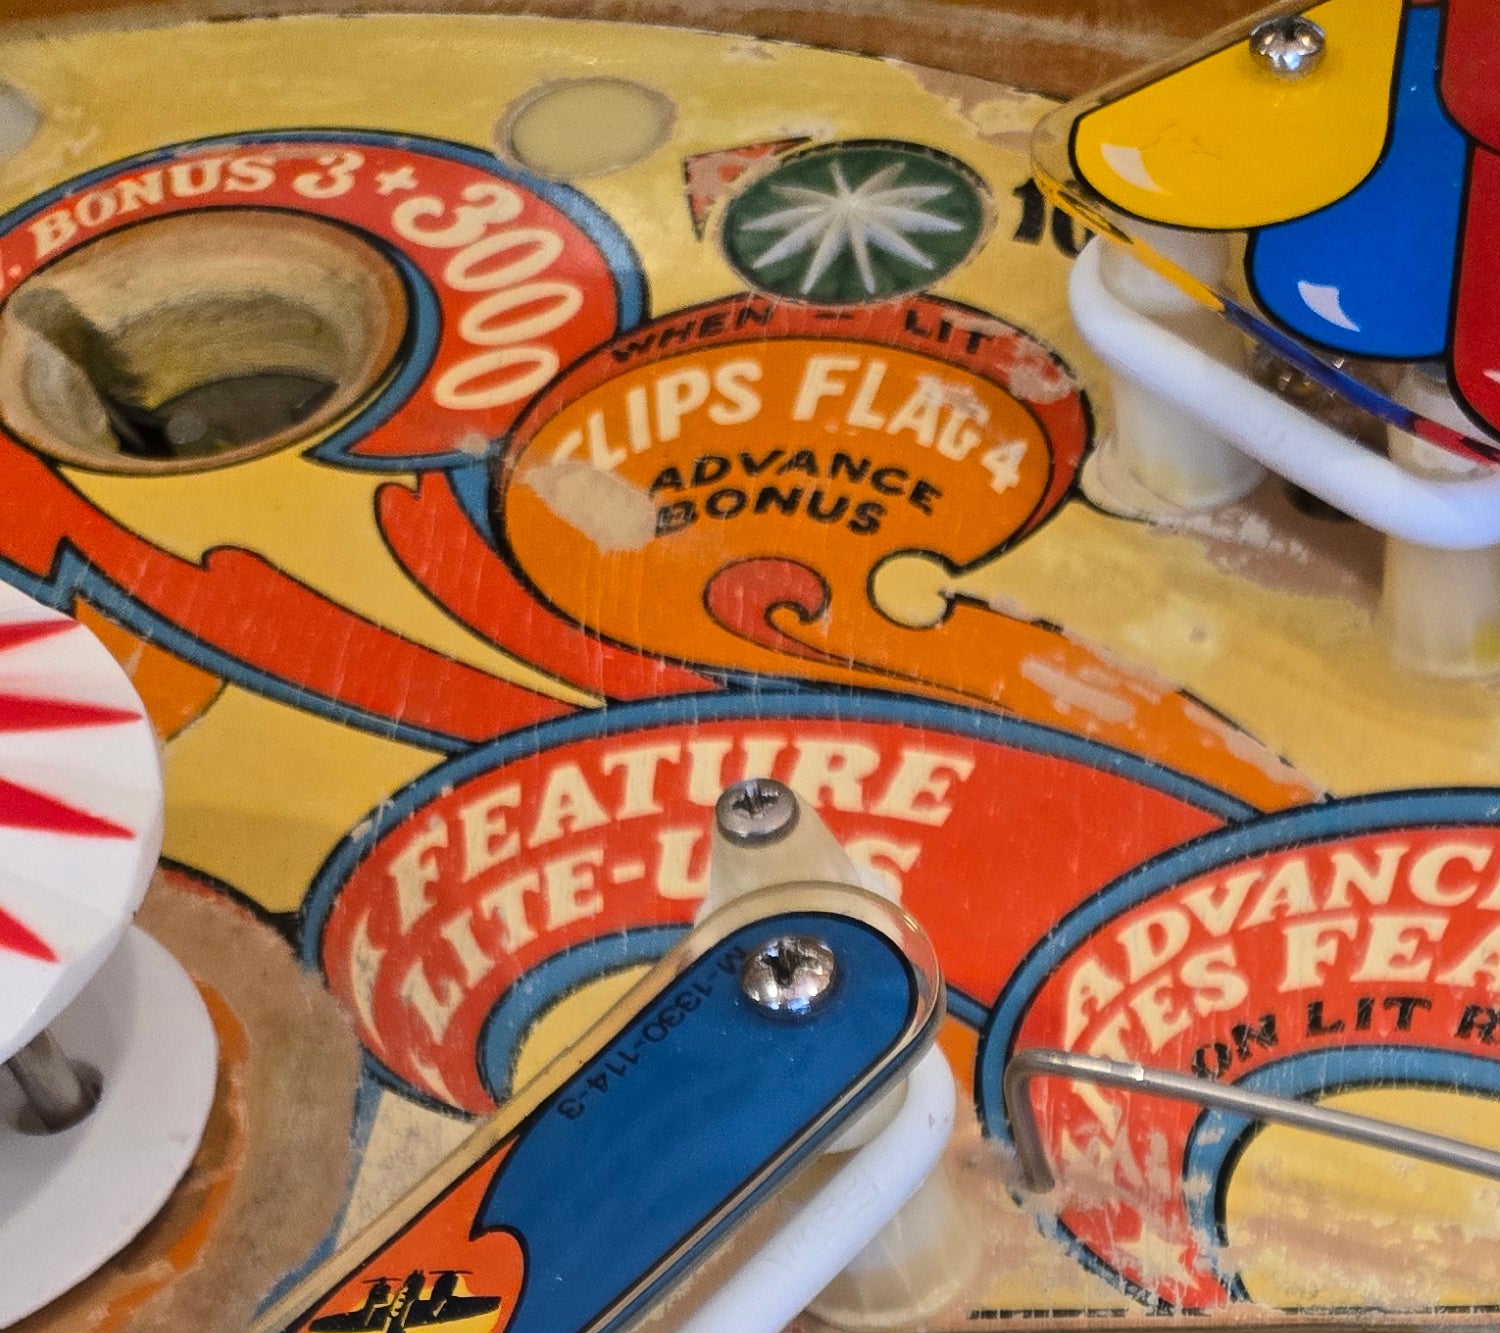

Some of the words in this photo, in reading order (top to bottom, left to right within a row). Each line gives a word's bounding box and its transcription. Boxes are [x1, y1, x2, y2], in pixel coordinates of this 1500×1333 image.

[28, 156, 276, 258] BONUS
[1011, 177, 1098, 259] 10
[612, 305, 774, 361] WHEN
[905, 309, 993, 353] LIT
[552, 358, 763, 475] LIPS
[792, 351, 990, 462] FLAG
[981, 439, 1028, 494] 4
[650, 448, 943, 517] ADVANCE
[655, 483, 887, 537] BONUS
[387, 736, 976, 937] FEATURE
[400, 828, 922, 1046] LITE-US
[1190, 1012, 1279, 1081] ON
[1305, 996, 1433, 1038] LIT
